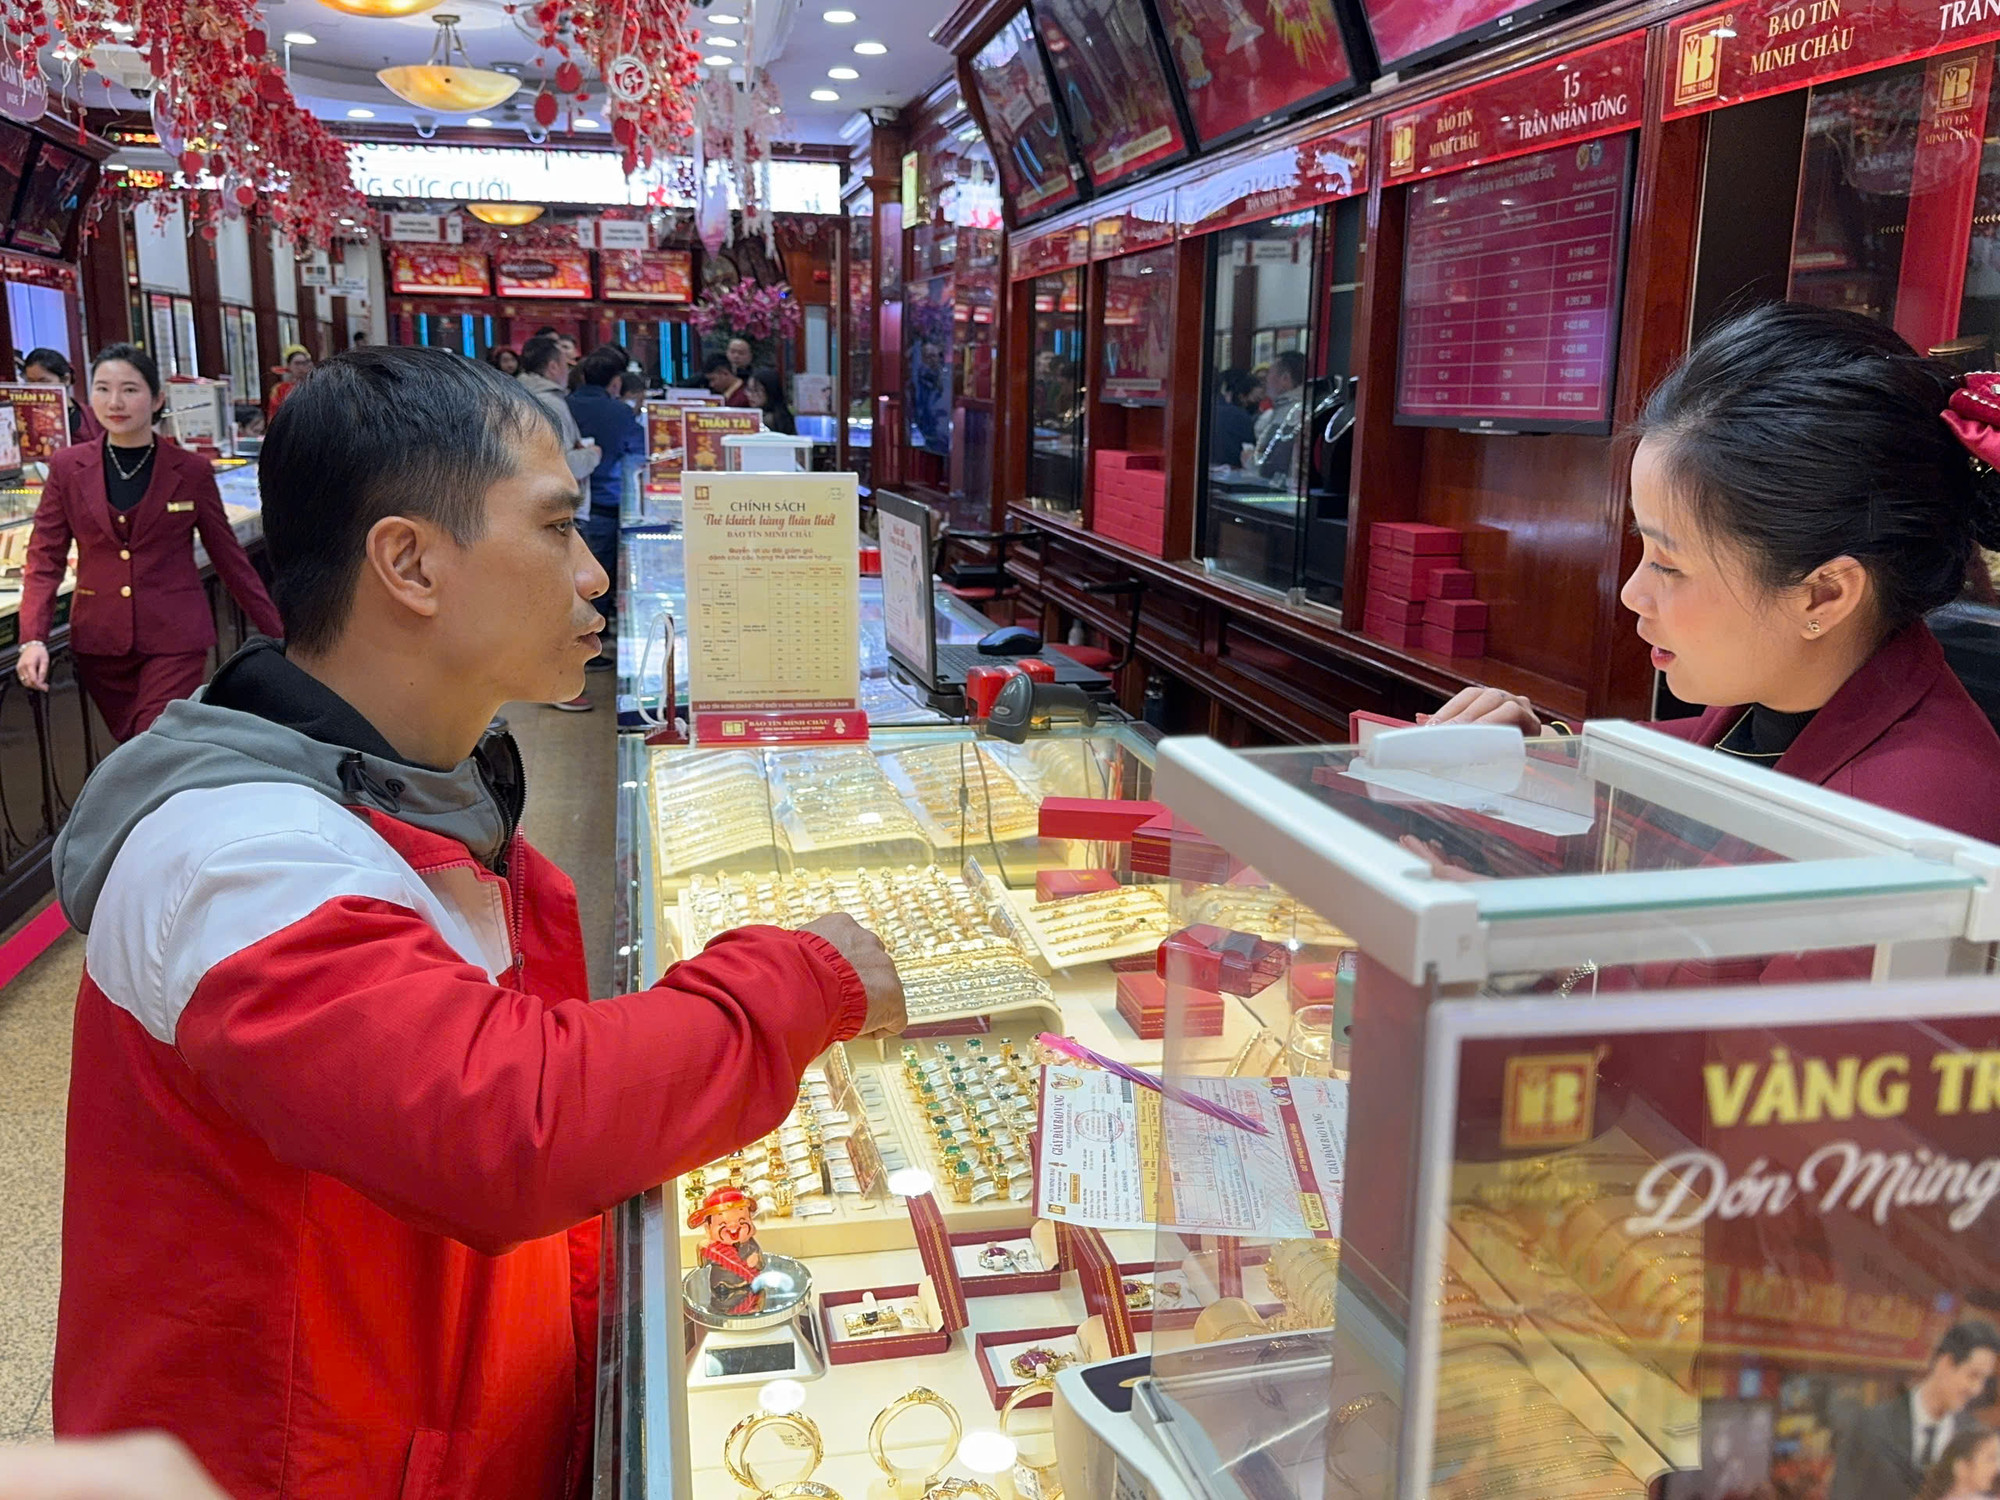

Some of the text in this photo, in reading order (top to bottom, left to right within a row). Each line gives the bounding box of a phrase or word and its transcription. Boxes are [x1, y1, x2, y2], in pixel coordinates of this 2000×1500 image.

[1768, 4, 1806, 38] BẢO
[1750, 26, 1855, 76] MINH CHÂU
[1563, 71, 1581, 99] 15
[1518, 93, 1628, 141] TRẦN NHÂN TÔNG
[698, 416, 752, 430] THẦN TÀI
[725, 513, 756, 526] khách
[759, 513, 785, 530] hàng
[788, 514, 811, 526] thân
[730, 499, 806, 512] CHÍNH SÁCH
[1704, 1046, 1911, 1128] VÀNG
[1797, 1140, 2000, 1232] Mừng
